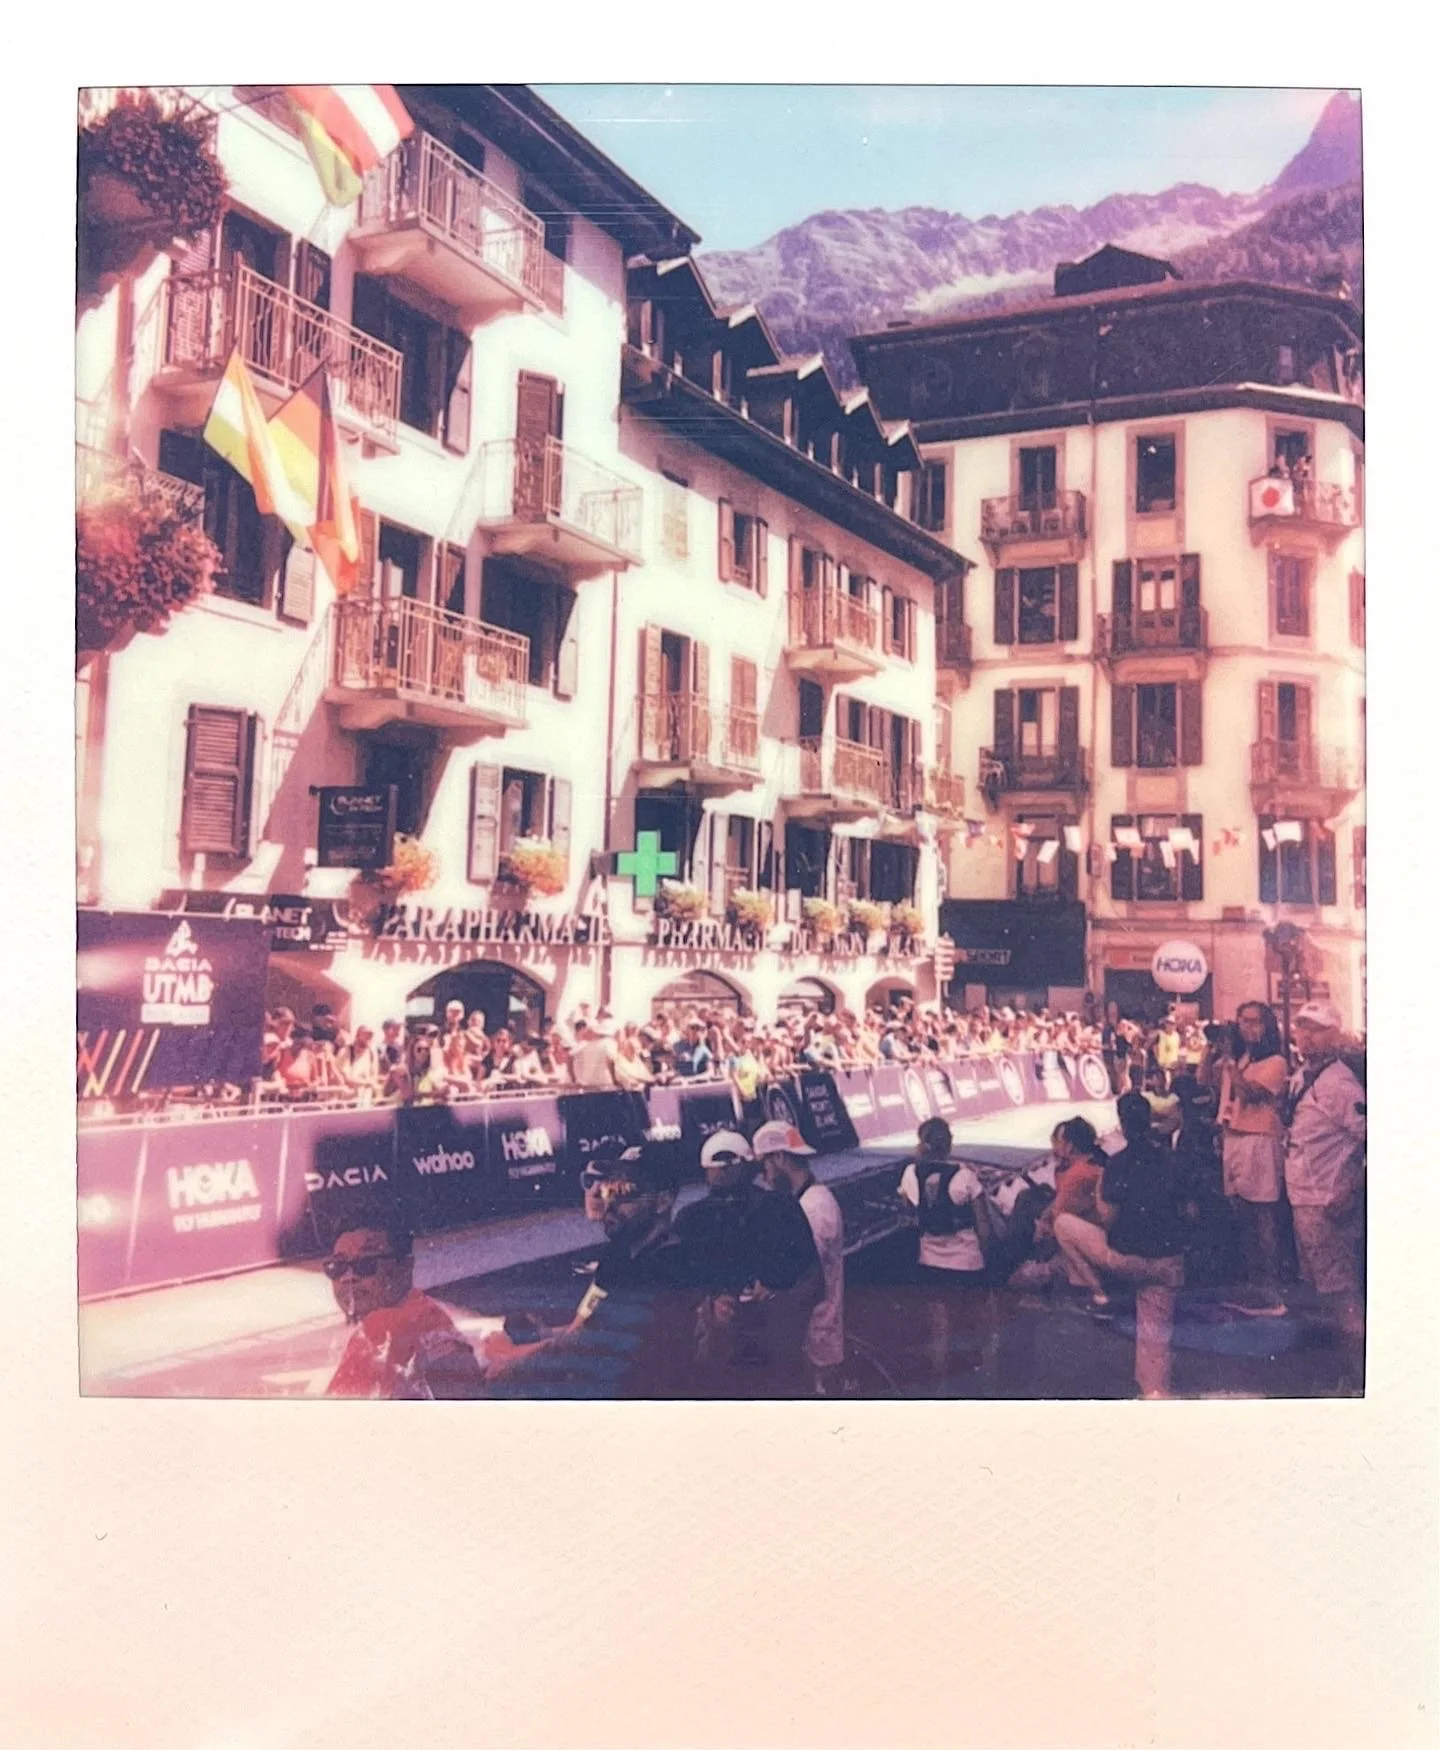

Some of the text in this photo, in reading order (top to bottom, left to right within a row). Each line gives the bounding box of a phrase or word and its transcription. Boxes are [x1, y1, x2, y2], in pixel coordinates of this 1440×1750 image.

[380, 903, 611, 946] PARAPHARMAIE
[143, 956, 213, 972] DACIA
[1156, 956, 1203, 973] HOKA
[412, 1144, 475, 1176] wahoo
[501, 1127, 553, 1161] HOKA
[167, 1158, 260, 1209] HOKA
[304, 1166, 388, 1192] DACIA
